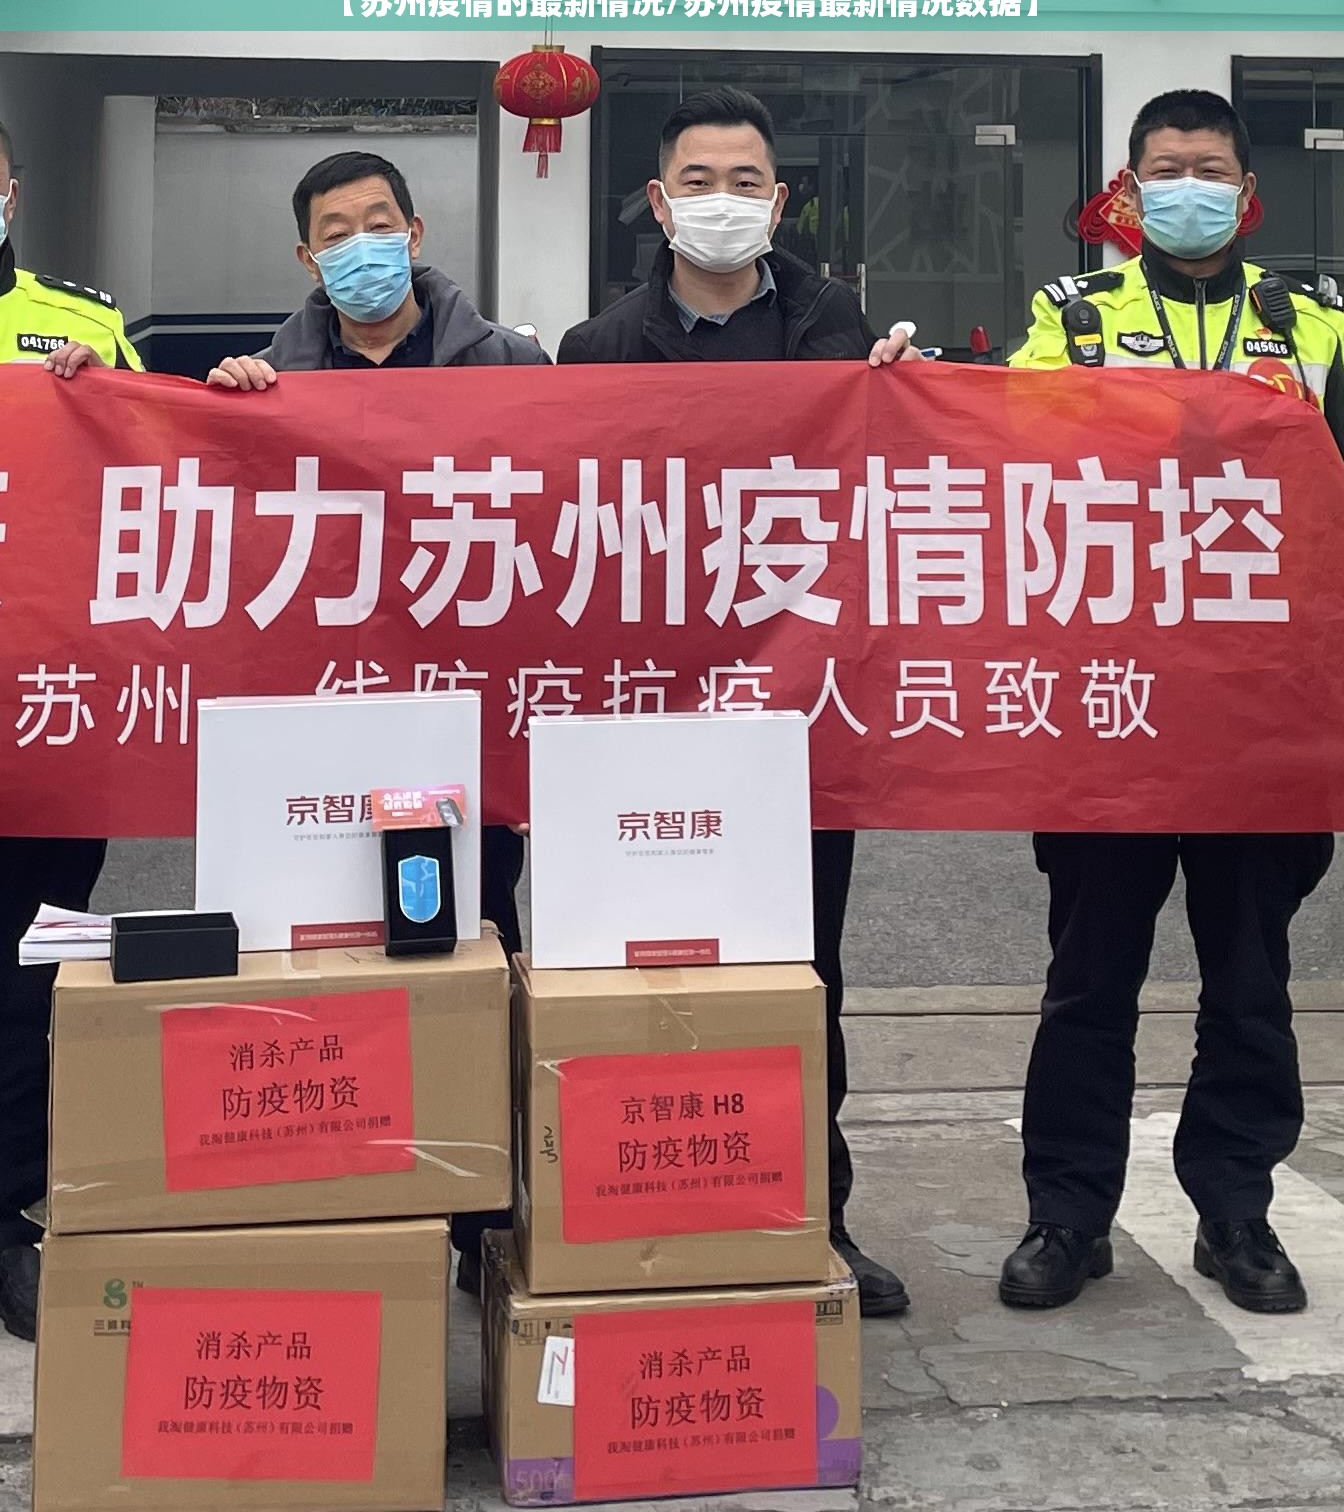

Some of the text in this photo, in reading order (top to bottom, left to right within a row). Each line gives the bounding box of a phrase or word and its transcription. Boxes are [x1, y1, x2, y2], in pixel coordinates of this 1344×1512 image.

[89, 455, 1290, 632] 助力苏州疫情防控
[617, 810, 723, 841] 京智康
[230, 1034, 344, 1072] 消杀产品
[222, 1075, 360, 1121] 防疫物资
[620, 1091, 745, 1125] 京智康 H8
[618, 1131, 751, 1173] 防疫物资
[196, 1331, 312, 1360] 消杀产品
[638, 1345, 751, 1380] 消杀产品
[183, 1374, 324, 1411] 防疫物资
[631, 1387, 765, 1430] 防疫物资
